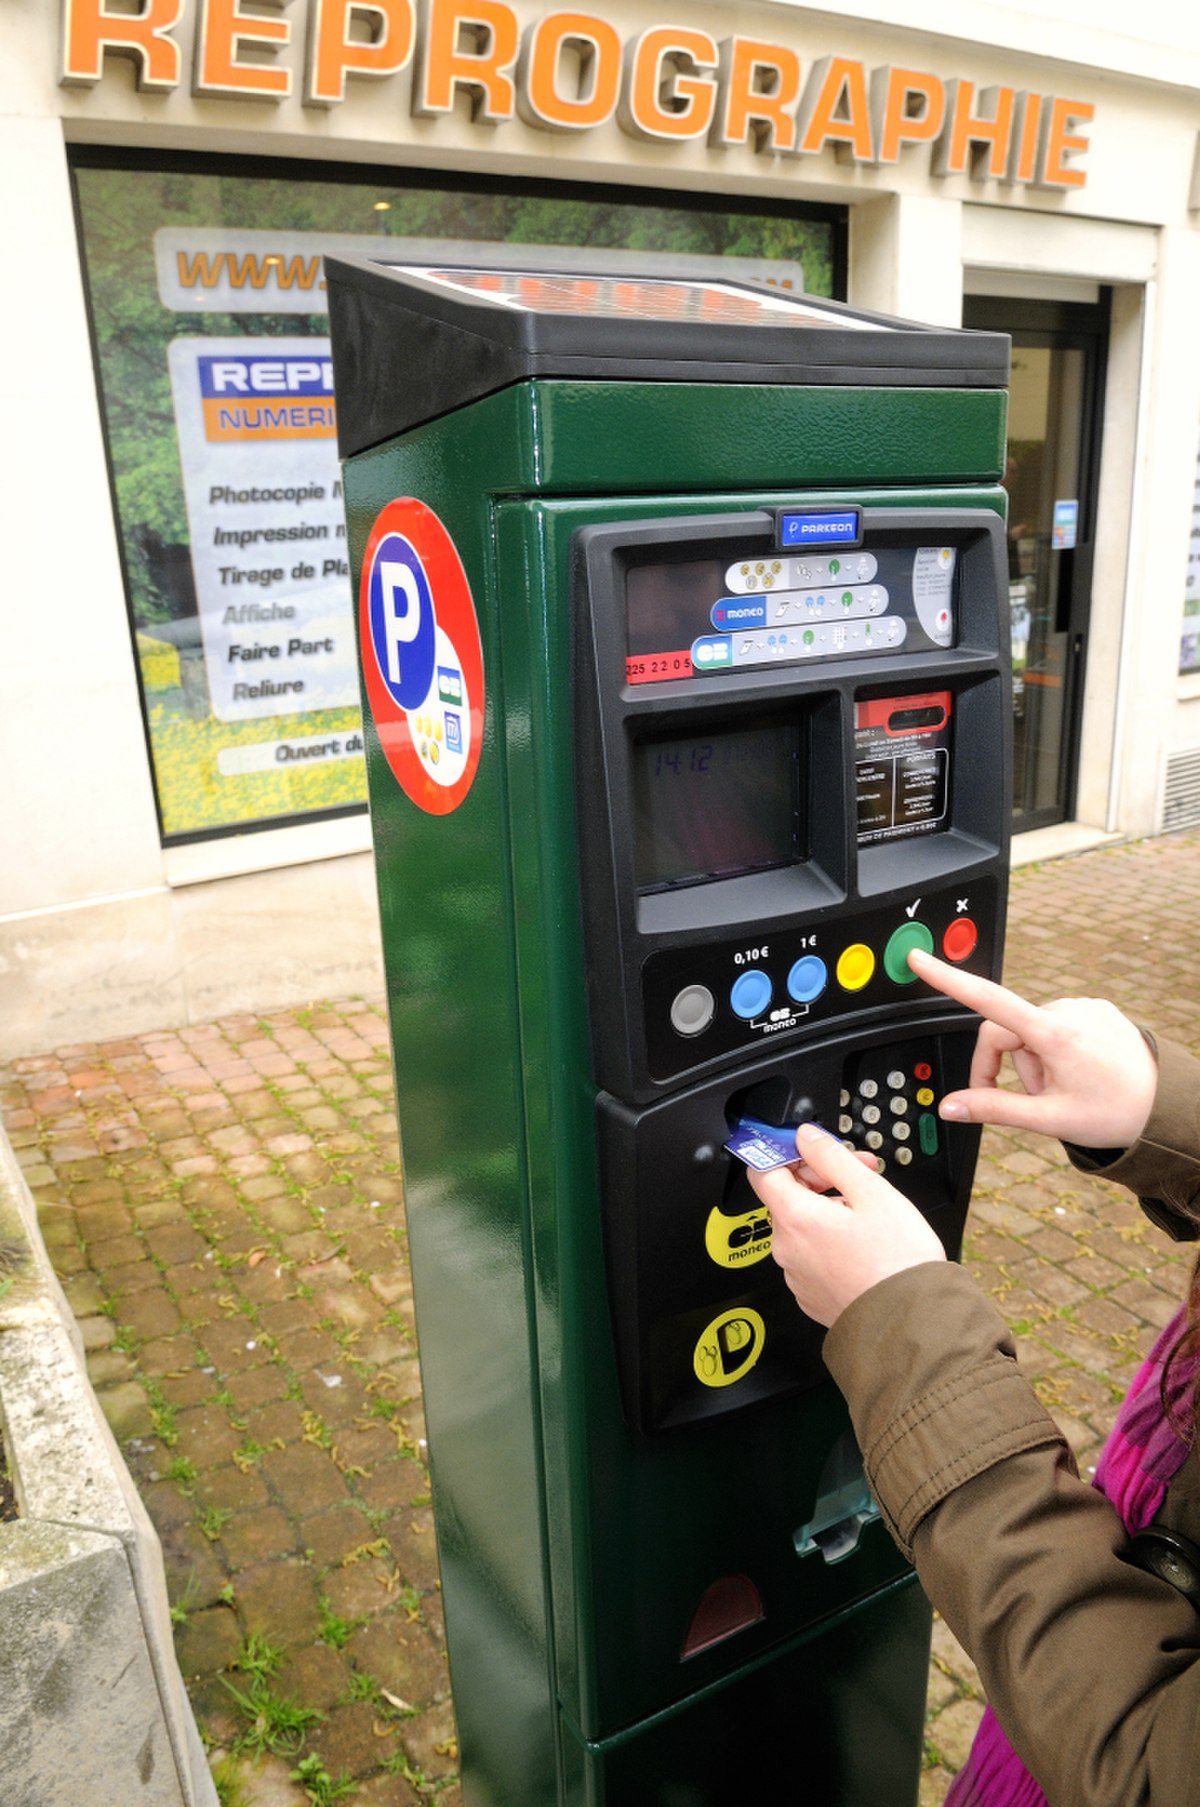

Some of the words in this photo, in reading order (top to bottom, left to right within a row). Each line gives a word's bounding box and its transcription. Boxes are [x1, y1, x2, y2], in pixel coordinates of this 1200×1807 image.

[61, 0, 1095, 188] REPROGRAPHIE
[209, 481, 325, 506] Photocopie
[214, 521, 328, 549] Impression
[801, 523, 853, 533] PARKEON
[218, 566, 284, 587] Tirage
[291, 561, 315, 579] de
[222, 602, 296, 624] Affiche
[380, 562, 421, 685] P
[228, 642, 280, 663] Faire
[288, 638, 333, 656] Part
[232, 678, 305, 701] Reliure
[275, 738, 340, 762] Ouvert
